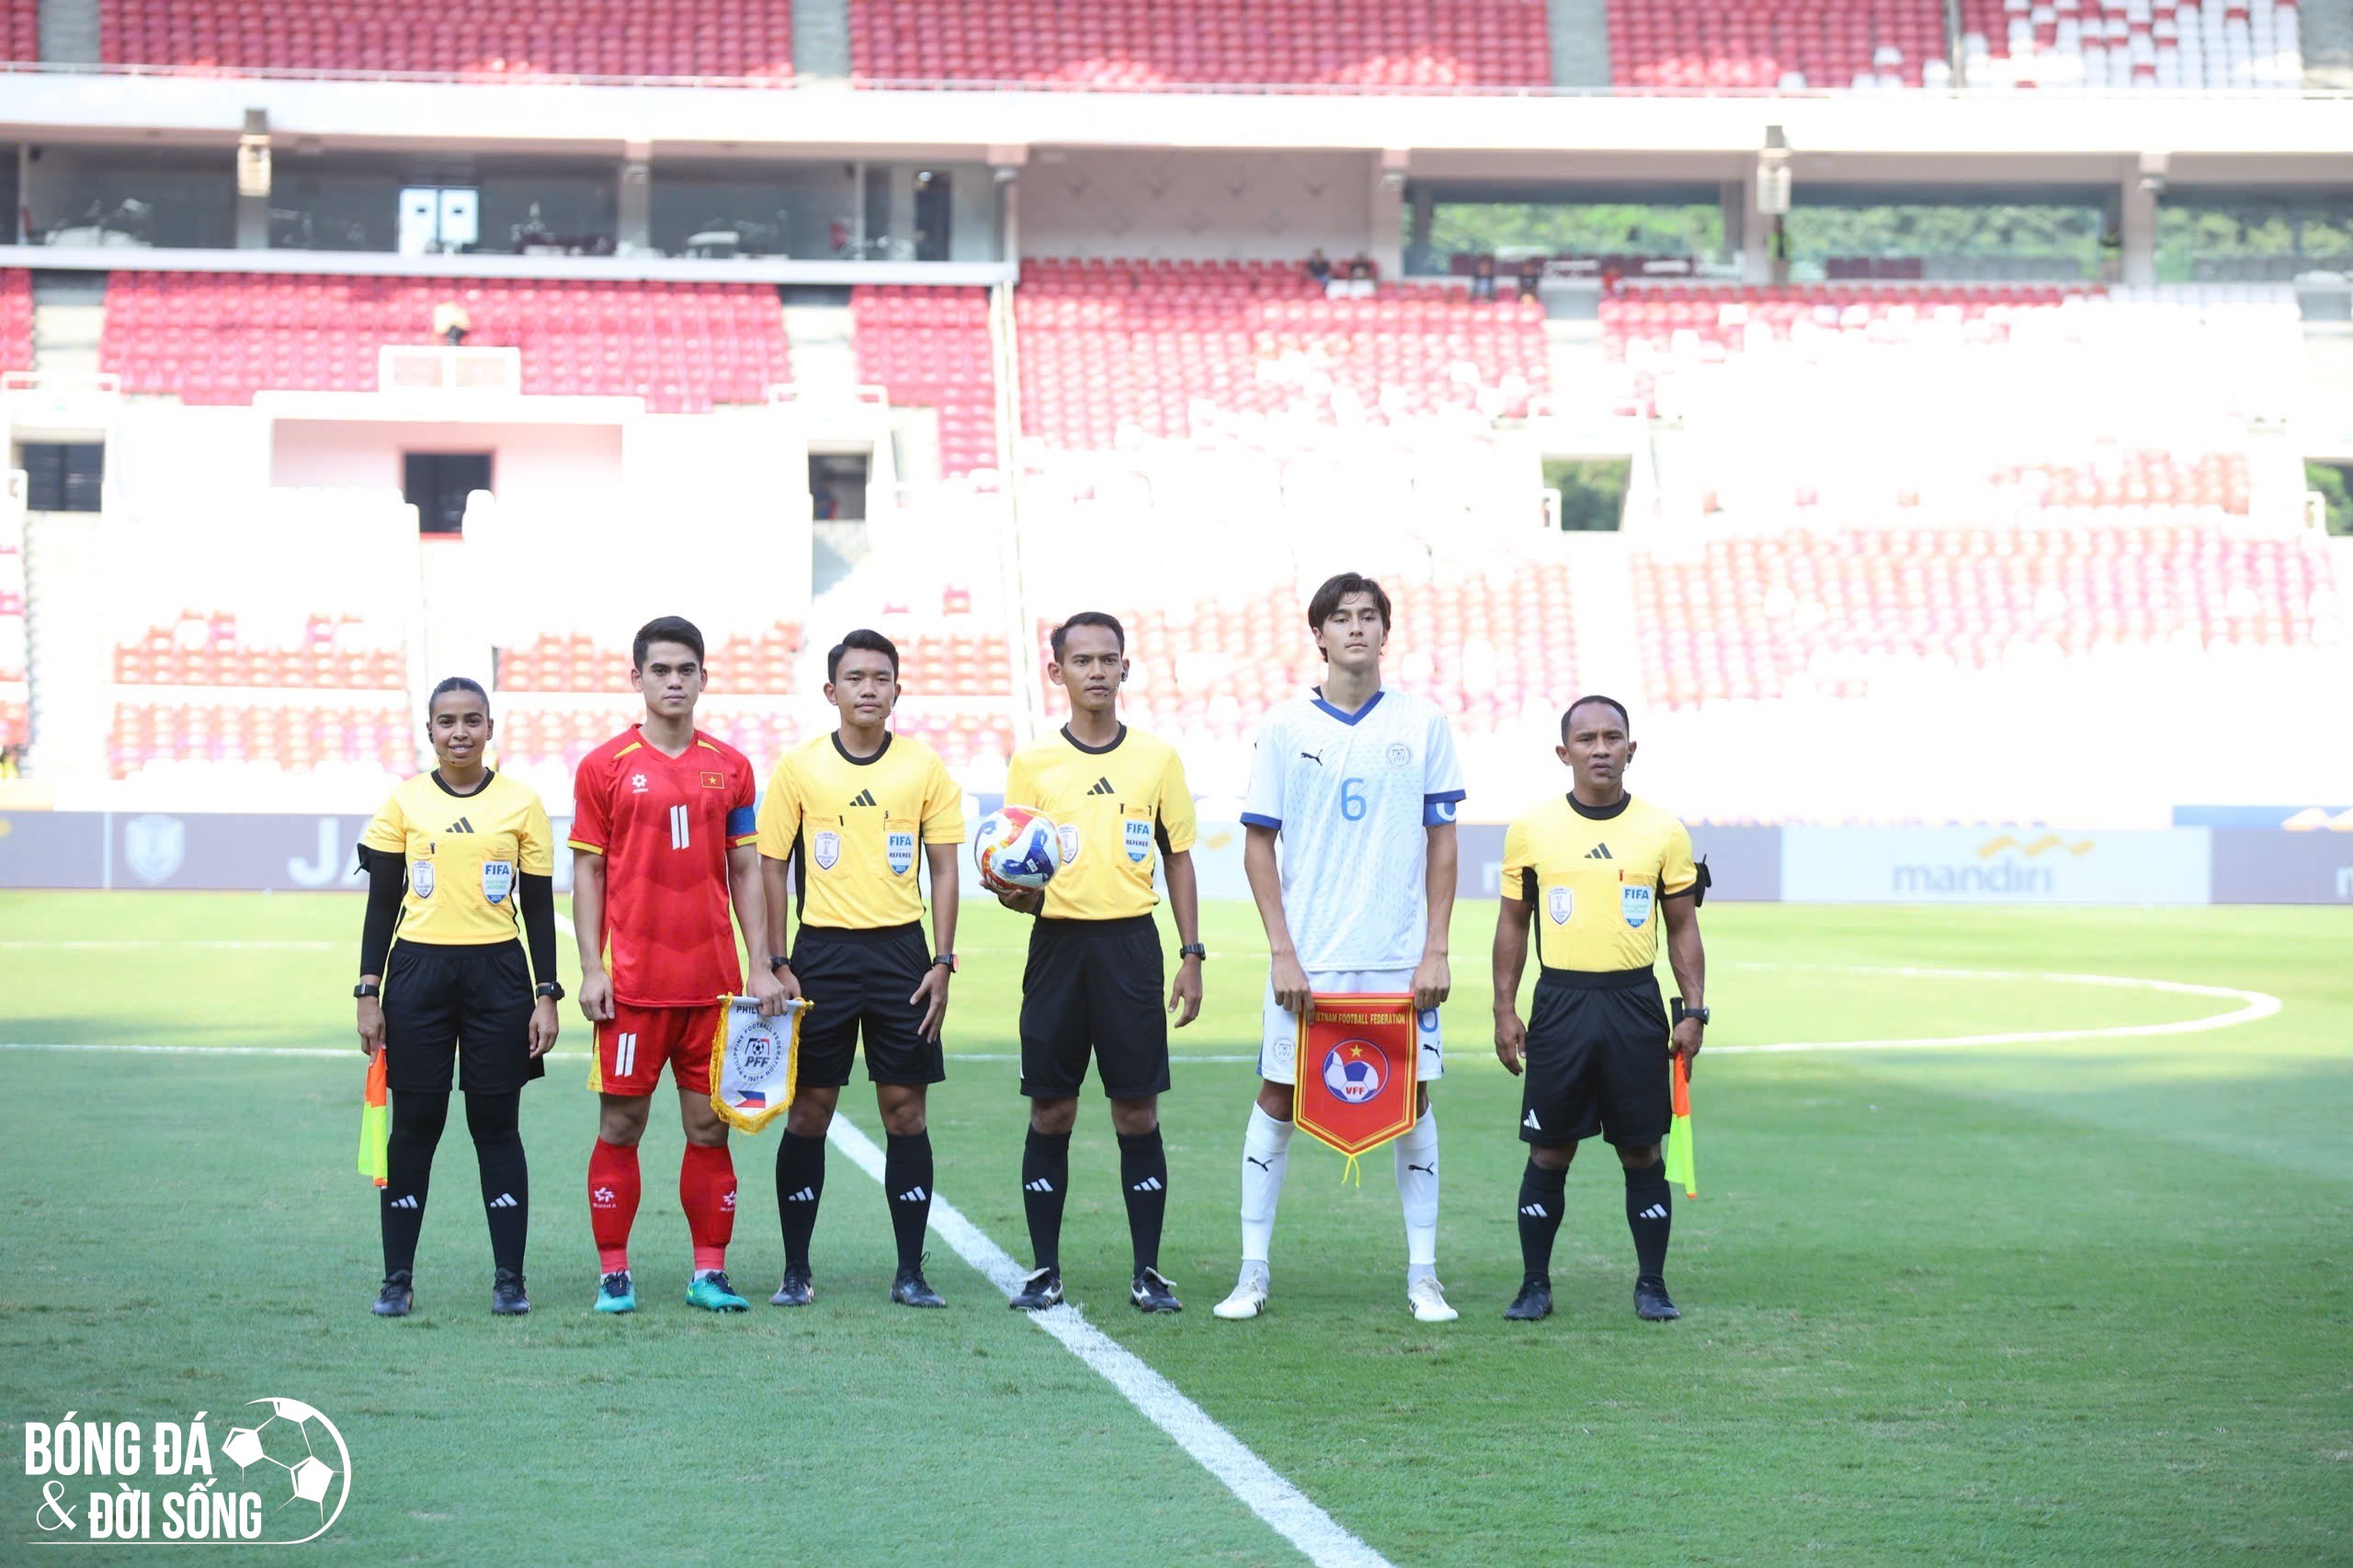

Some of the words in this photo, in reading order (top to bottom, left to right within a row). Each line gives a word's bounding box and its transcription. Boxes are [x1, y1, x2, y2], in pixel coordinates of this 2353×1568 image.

[1341, 778, 1367, 821] 6
[670, 804, 689, 850] 11
[1127, 824, 1149, 835] FIFA
[890, 836, 912, 846] FIFA
[485, 865, 509, 875] FIFA
[1625, 889, 1649, 899] FIFA
[1338, 1013, 1368, 1024] FOOTBALL
[1370, 1014, 1405, 1024] FEDERATION
[745, 1022, 772, 1033] FOOTBALL
[615, 1033, 636, 1077] 11
[745, 1056, 770, 1067] PFF
[1346, 1086, 1365, 1095] VFF
